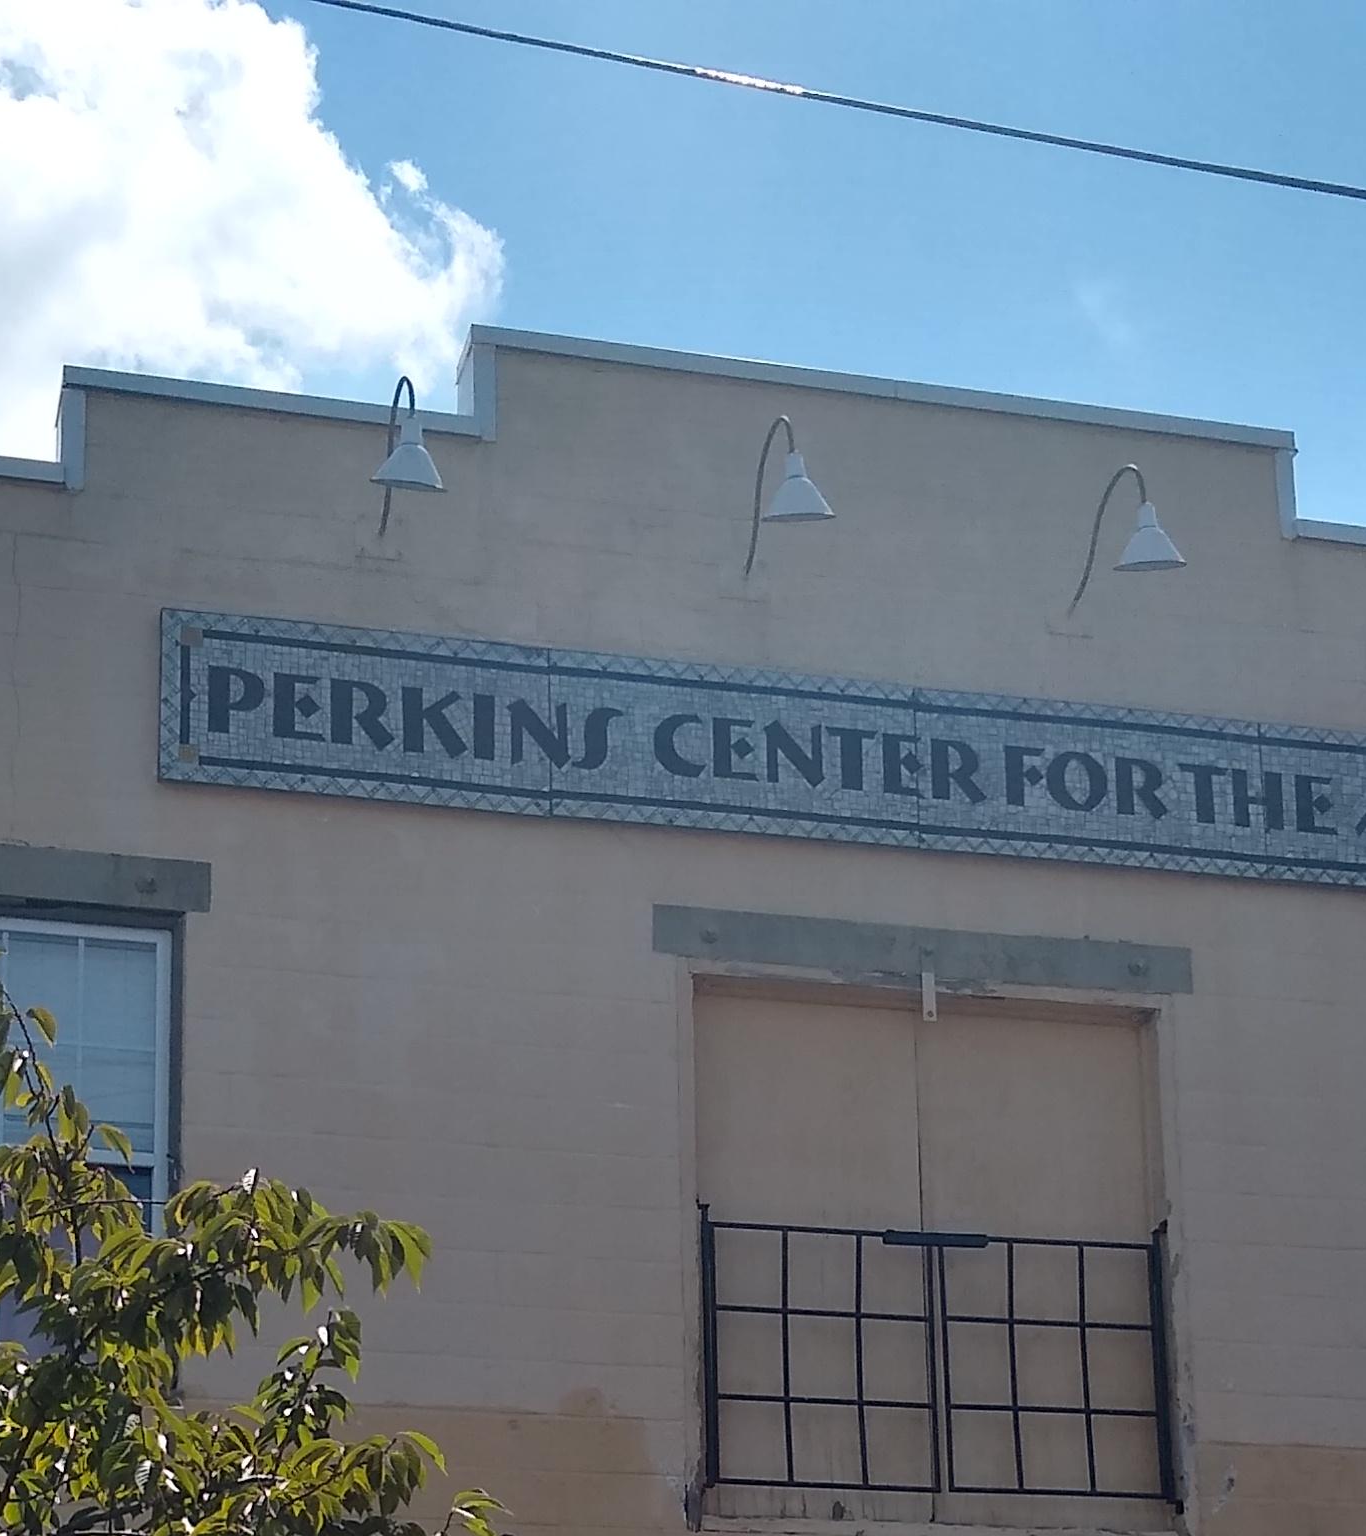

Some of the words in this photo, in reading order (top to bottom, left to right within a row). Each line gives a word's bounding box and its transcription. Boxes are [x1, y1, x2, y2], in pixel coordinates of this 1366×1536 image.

[207, 664, 624, 770] PERKINS
[653, 713, 988, 804] CENTER
[1003, 745, 1169, 819] FOR
[1177, 763, 1338, 835] THE
